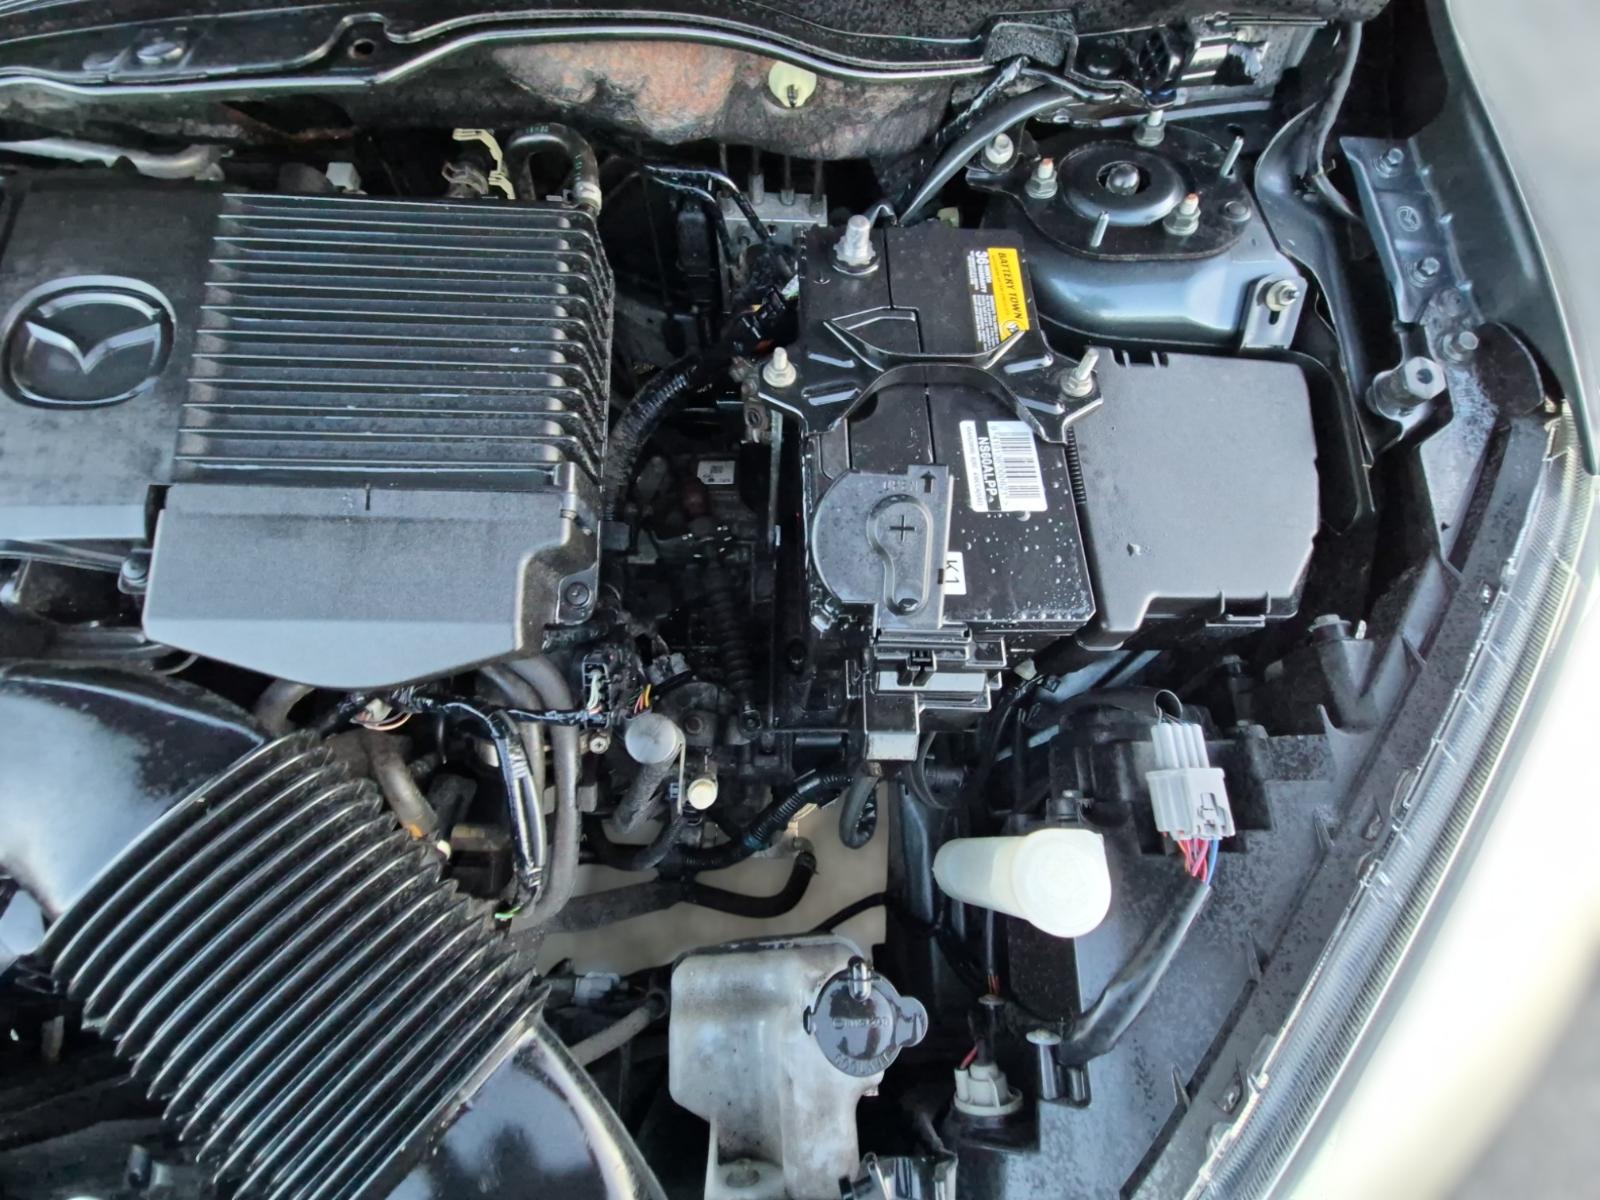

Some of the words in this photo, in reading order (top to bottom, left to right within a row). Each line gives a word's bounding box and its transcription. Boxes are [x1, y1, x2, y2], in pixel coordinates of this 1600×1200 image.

[975, 250, 989, 265] 36
[998, 252, 1016, 291] BATTERY
[1009, 292, 1023, 320] TOWN
[977, 436, 998, 496] NS60ALPP
[945, 559, 960, 585] K1
